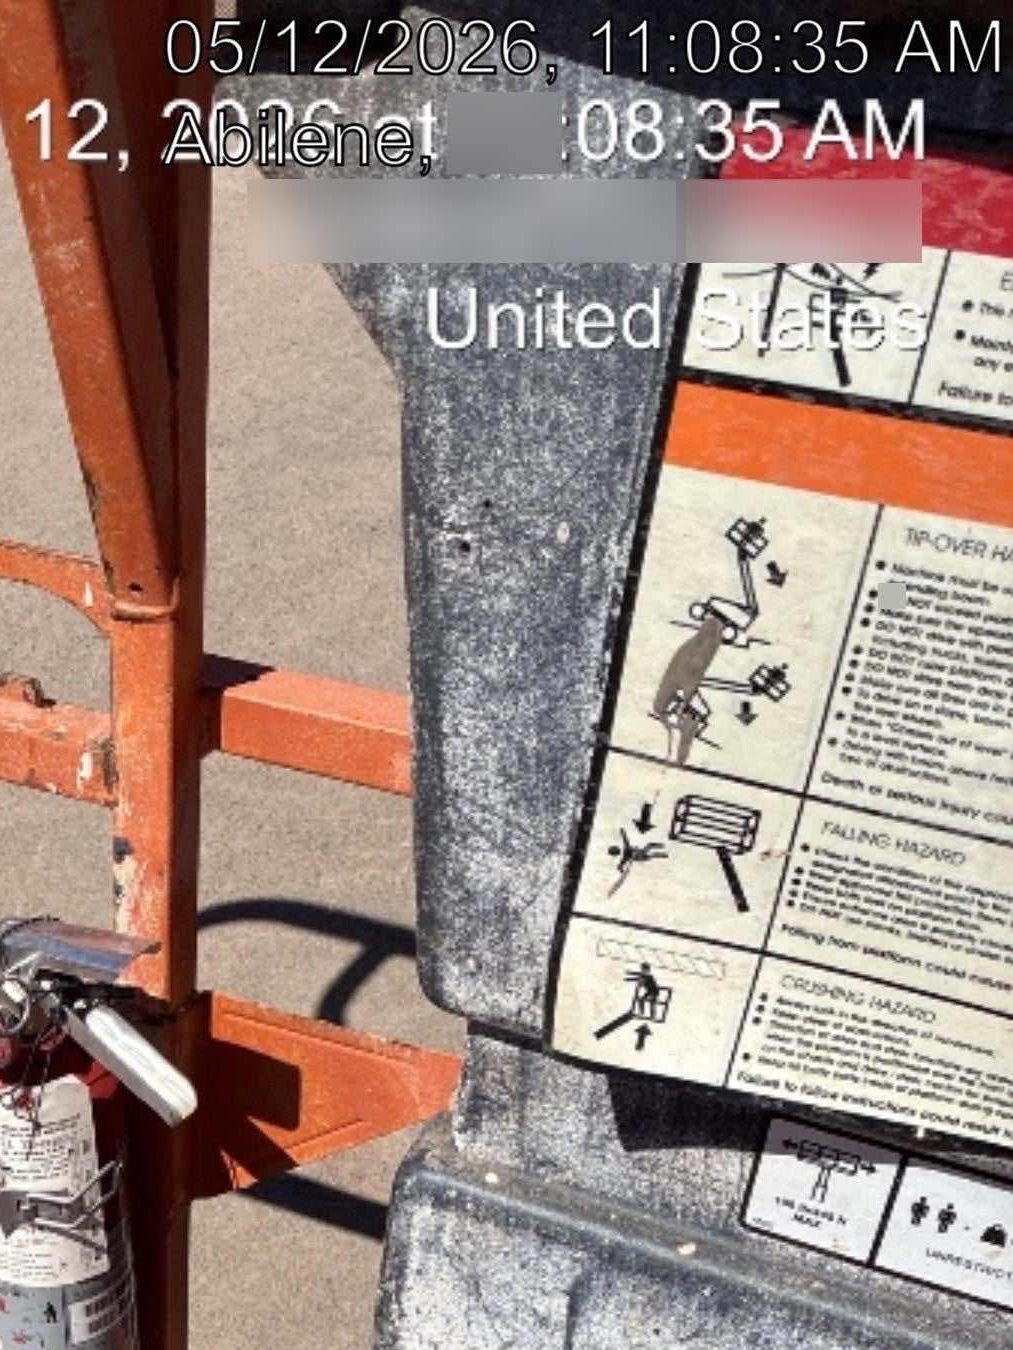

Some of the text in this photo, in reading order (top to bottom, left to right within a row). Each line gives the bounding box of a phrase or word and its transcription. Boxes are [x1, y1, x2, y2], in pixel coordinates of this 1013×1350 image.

[940, 380, 993, 402] Failure
[906, 527, 987, 558] TIP-OVER
[820, 821, 967, 867] FALLING HAZARD
[780, 973, 937, 1024] CRUSHING HAZARD
[737, 1070, 781, 1091] Failure
[784, 1080, 798, 1093] to
[841, 1091, 918, 1118] instructions
